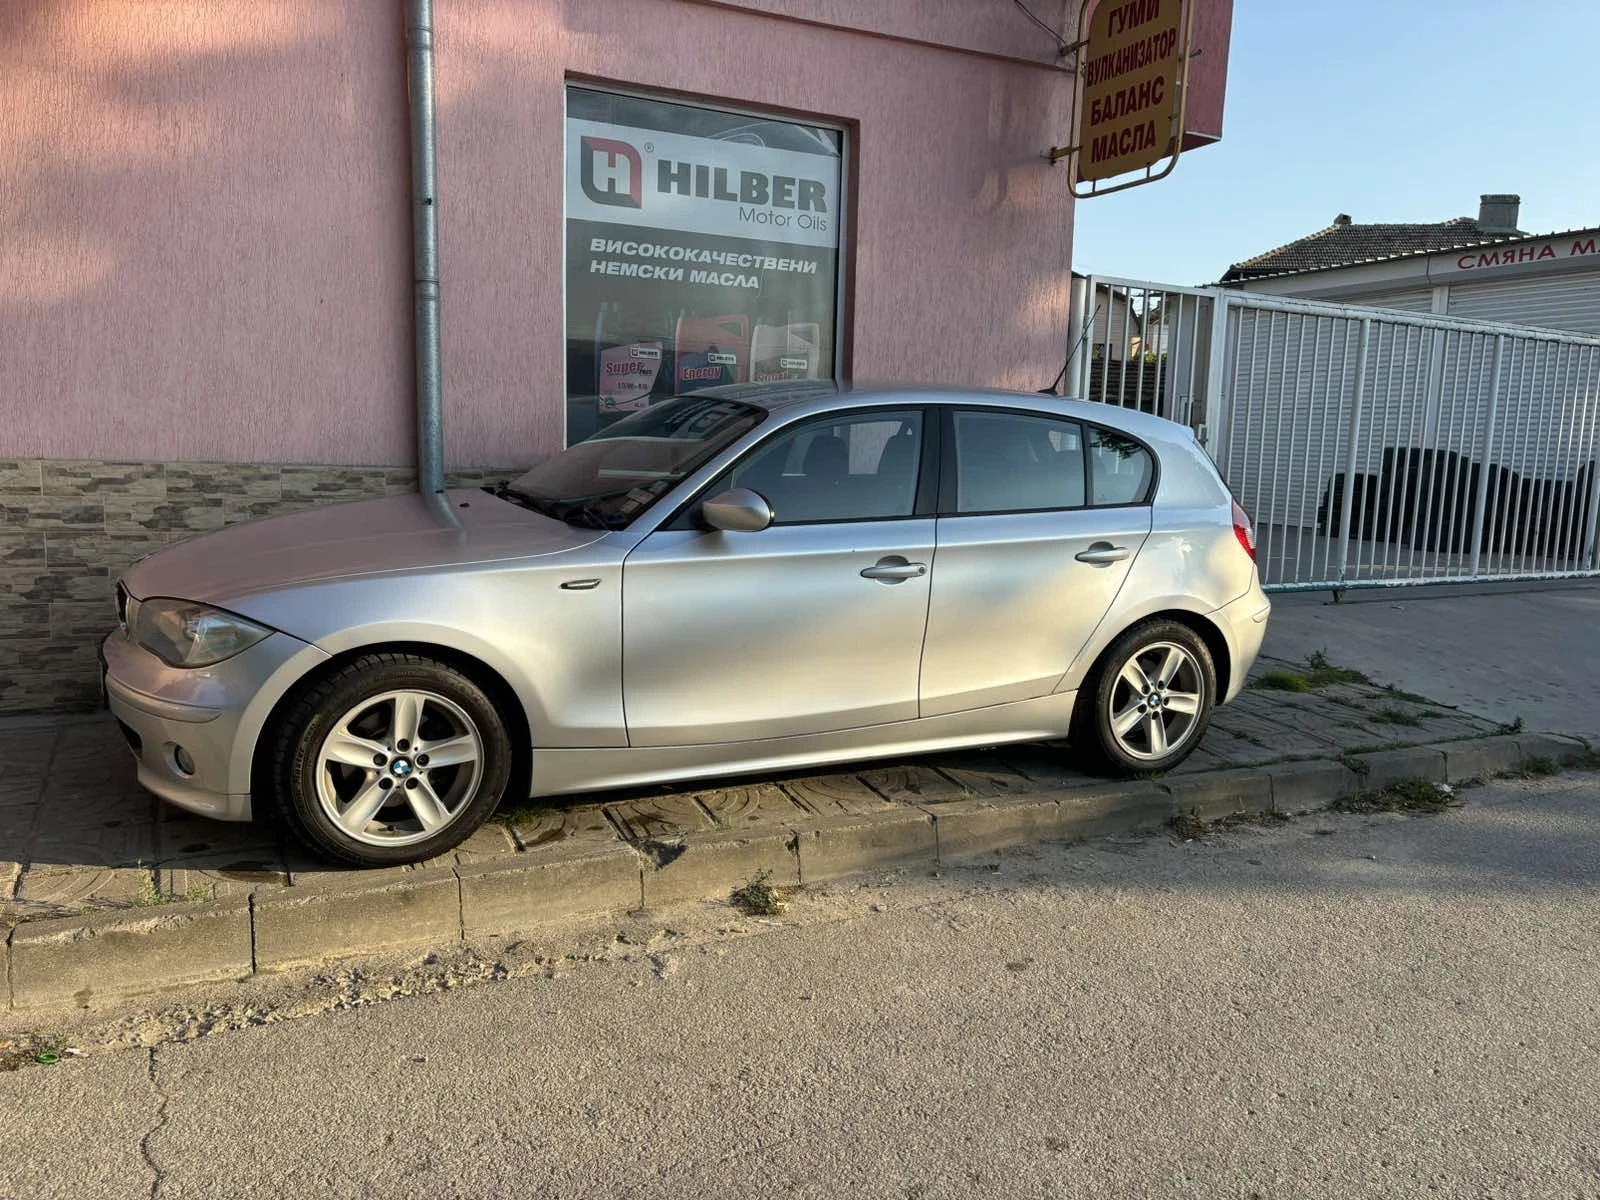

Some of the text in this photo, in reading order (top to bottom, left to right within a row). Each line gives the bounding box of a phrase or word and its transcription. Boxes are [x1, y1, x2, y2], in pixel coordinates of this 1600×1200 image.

[1107, 0, 1160, 38] ГУМИ
[1087, 27, 1177, 88] ВУЛКАНИЗАТОР
[1090, 75, 1165, 126] БАЛАНС
[1091, 120, 1156, 163] МАСЛА
[657, 159, 828, 213] HILBER
[738, 206, 828, 232] Motor Oils
[590, 238, 818, 274] ВИСОКОКАЧЕСТВЕНИ
[1457, 239, 1600, 270] СМЯНА М
[590, 259, 760, 289] НЕМСКИ МАСЛА
